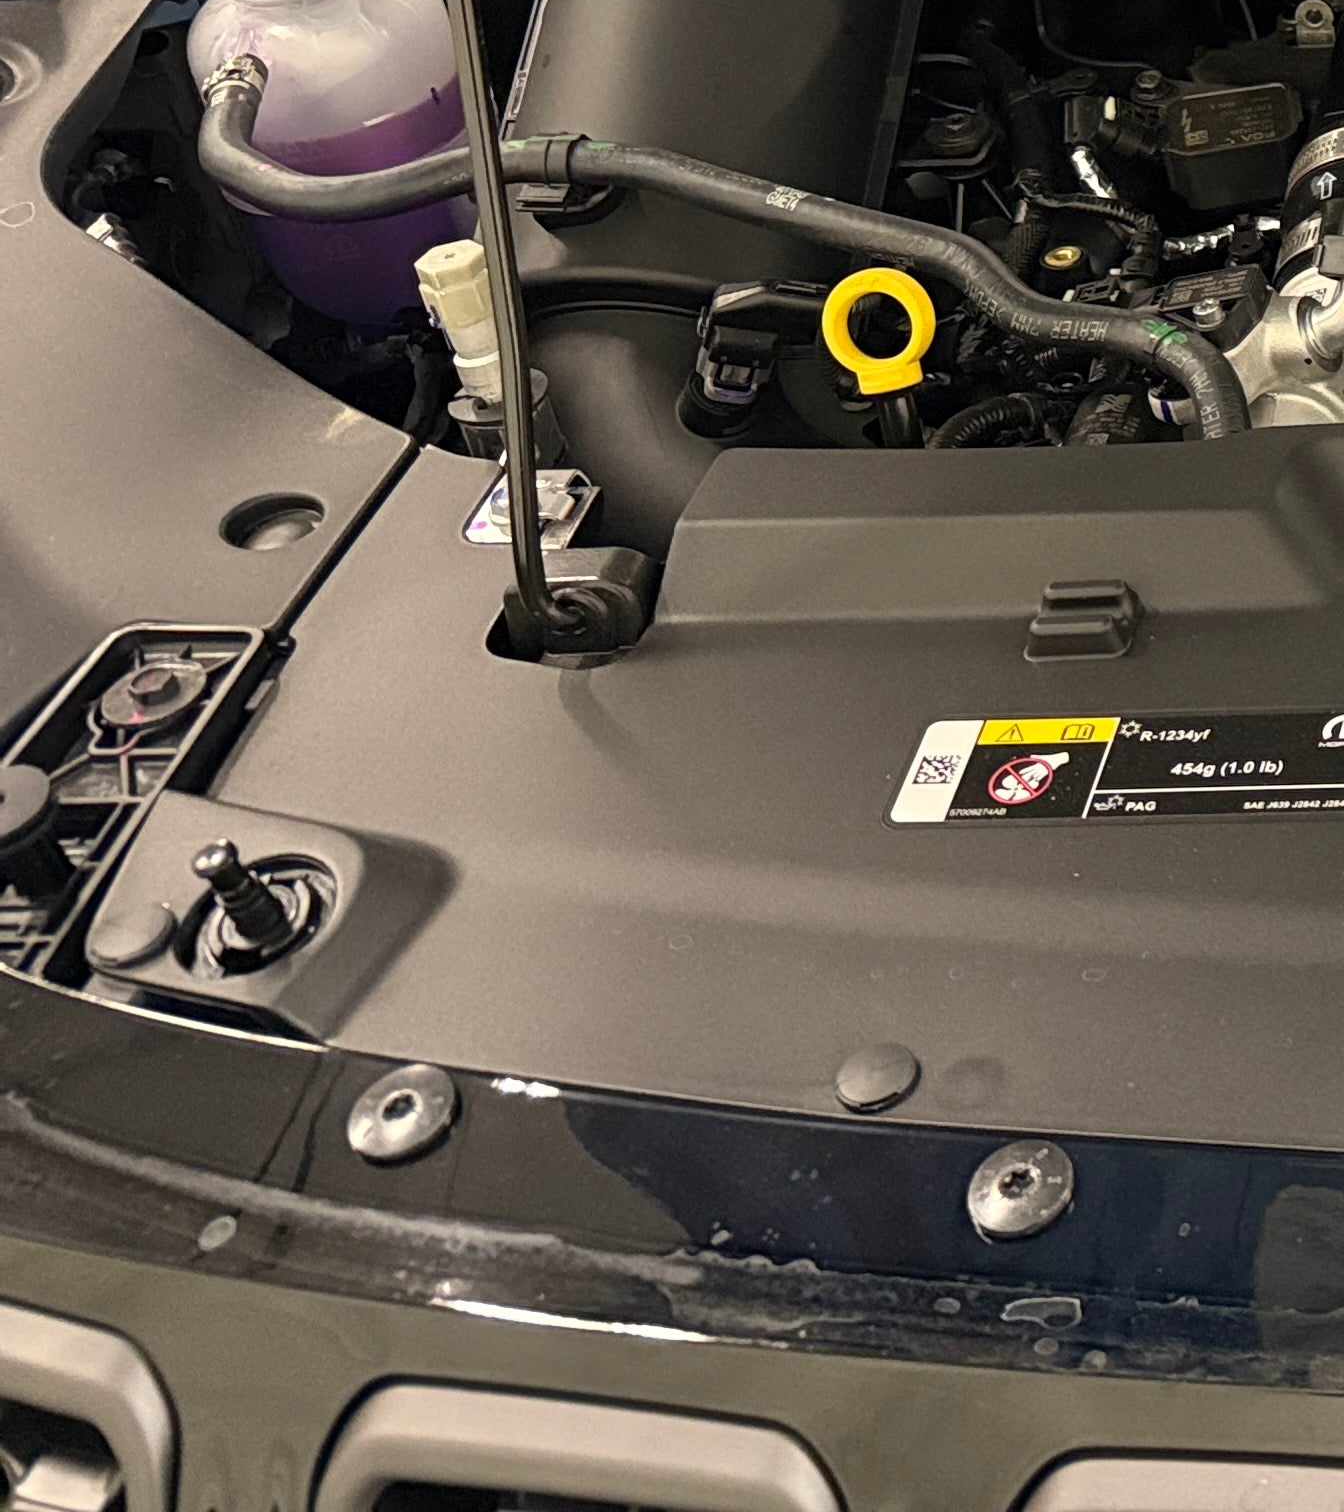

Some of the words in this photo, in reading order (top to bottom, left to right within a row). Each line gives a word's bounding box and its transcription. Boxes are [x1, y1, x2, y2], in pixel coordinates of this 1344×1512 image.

[1051, 319, 1109, 342] HEATER
[1139, 728, 1211, 742] R-1234yf
[1170, 762, 1215, 777] 454g
[1220, 761, 1255, 776] (1.0
[1259, 759, 1284, 775] lb)
[1125, 800, 1157, 812] PAG
[1243, 801, 1265, 810] SAE
